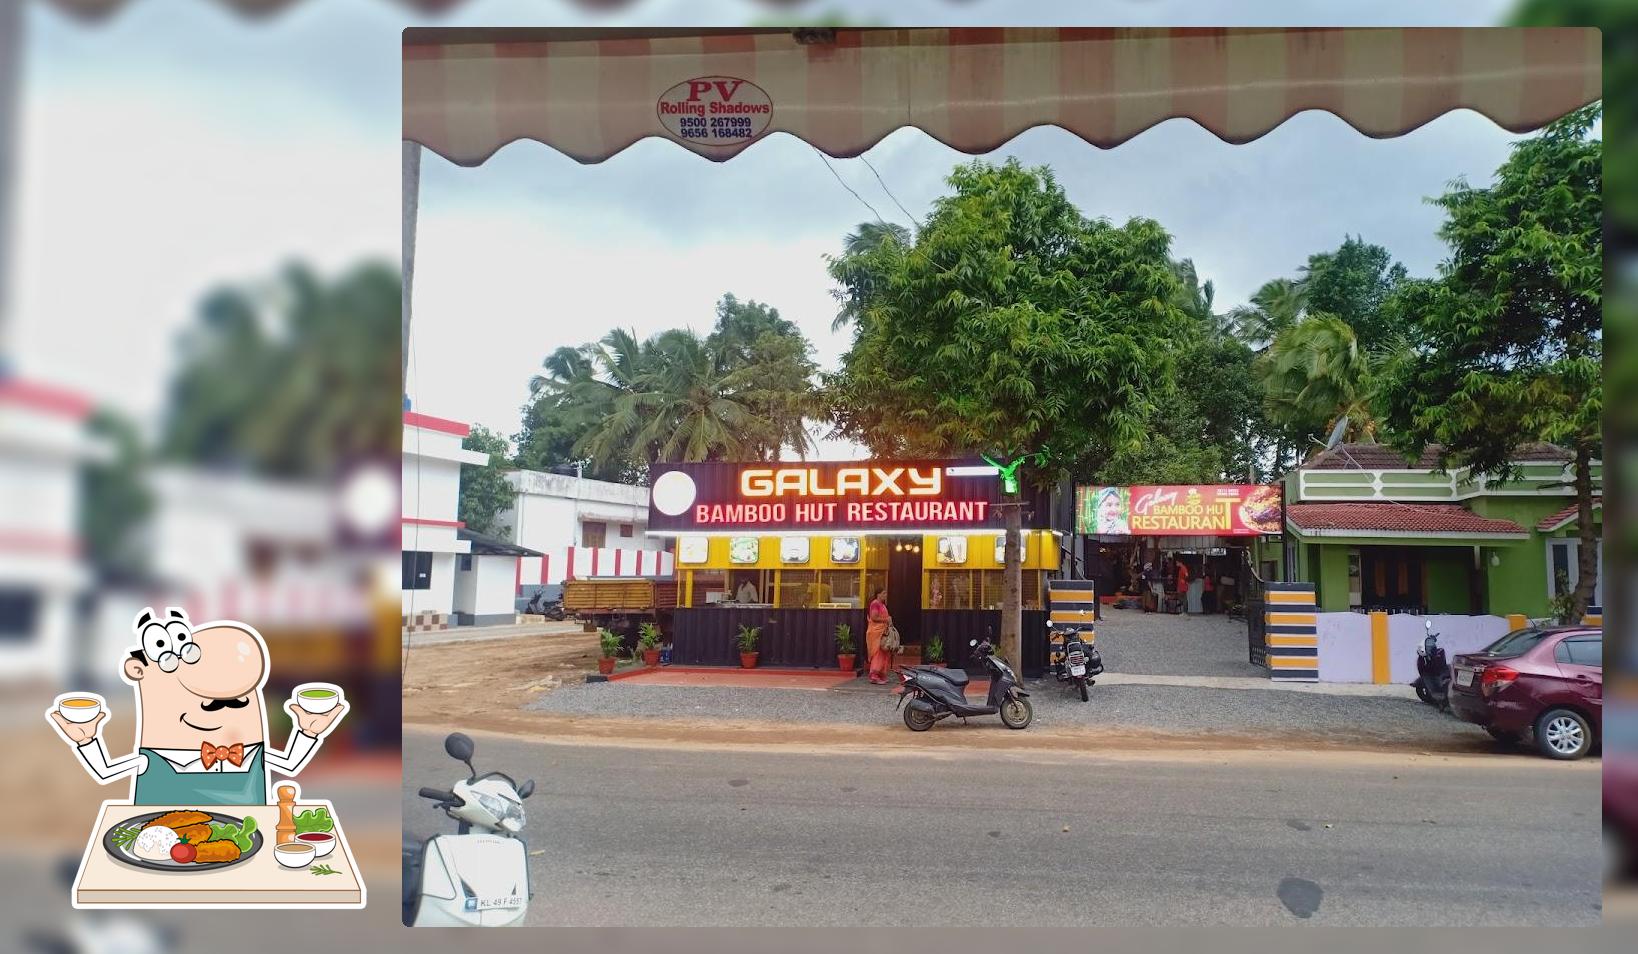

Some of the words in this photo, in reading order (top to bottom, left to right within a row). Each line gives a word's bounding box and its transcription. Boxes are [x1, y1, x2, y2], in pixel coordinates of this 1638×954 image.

[686, 80, 743, 102] PV
[661, 102, 705, 117] Rolling
[709, 102, 770, 114] Shadows
[680, 117, 707, 127] 9500
[711, 117, 752, 127] 267999
[681, 128, 708, 138] 9656
[712, 128, 752, 138] 168482
[741, 468, 942, 497] GALAXY
[696, 503, 786, 523] BAMBOO
[795, 503, 838, 522] HUT
[848, 501, 988, 521] RESTAURANT
[1153, 504, 1203, 515] BAMBOO
[480, 899, 491, 907] KL
